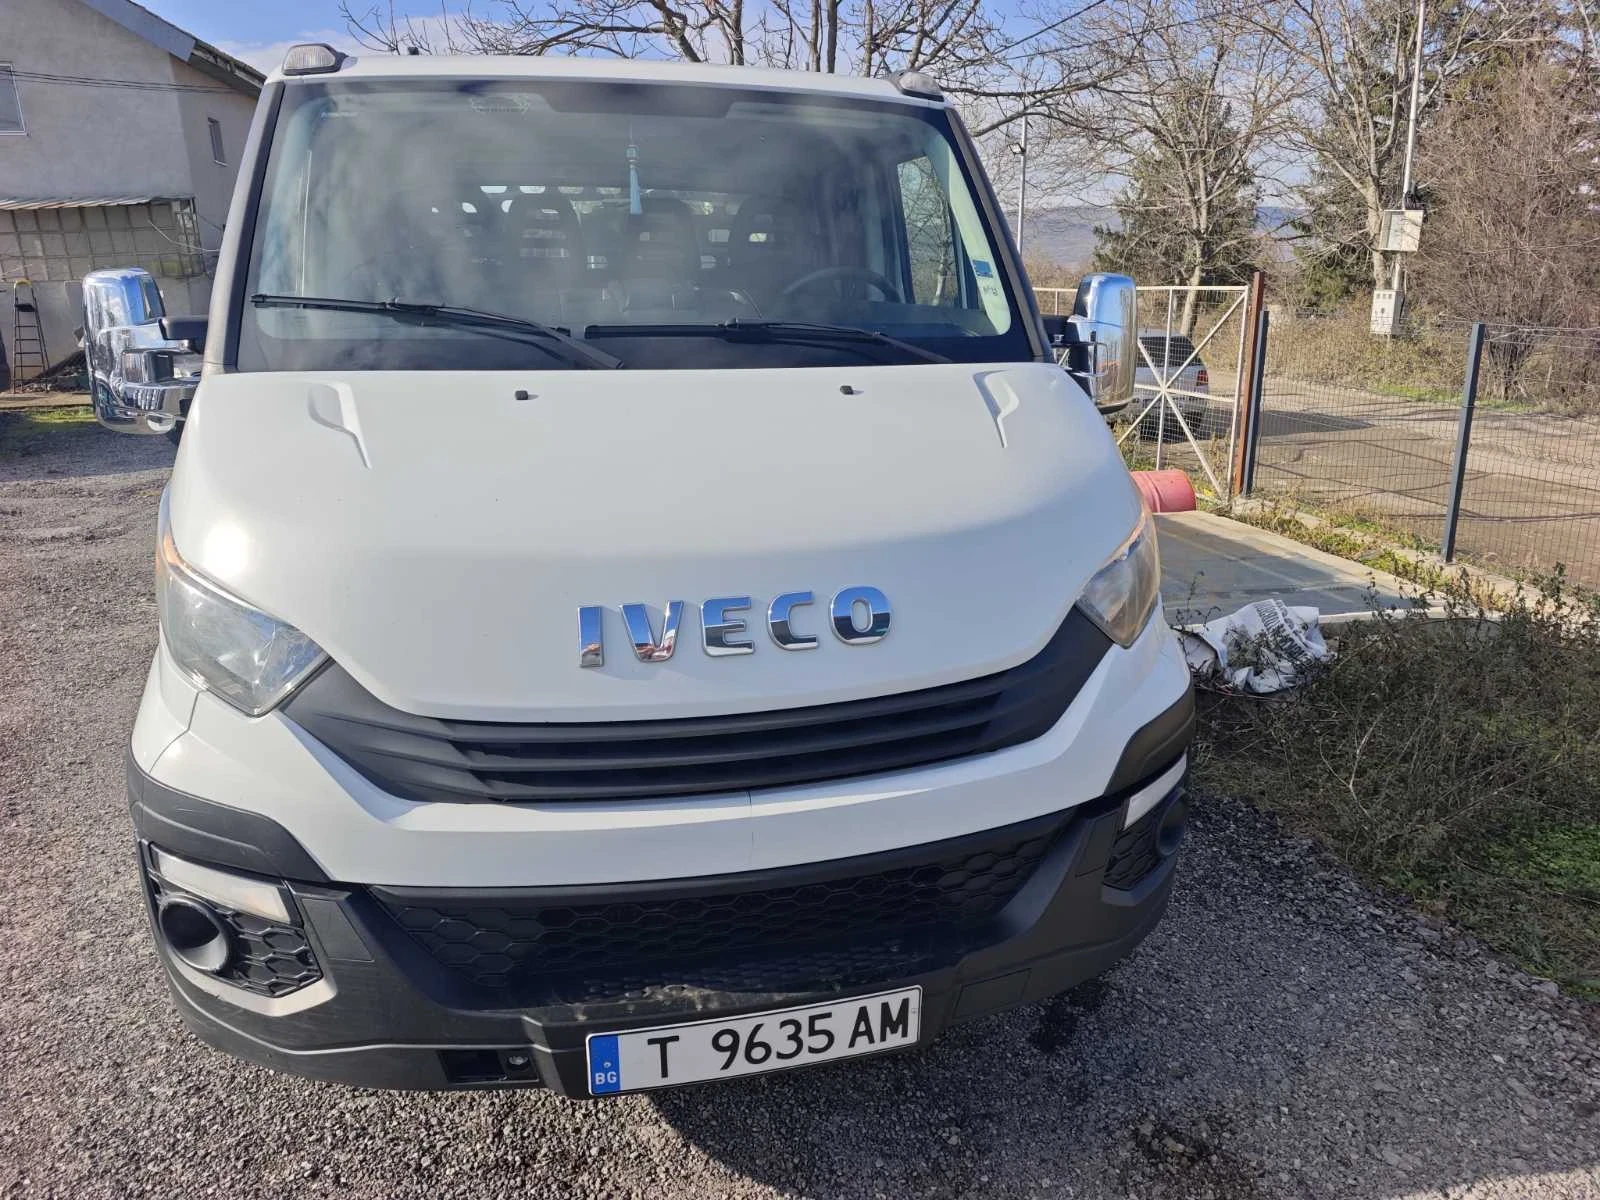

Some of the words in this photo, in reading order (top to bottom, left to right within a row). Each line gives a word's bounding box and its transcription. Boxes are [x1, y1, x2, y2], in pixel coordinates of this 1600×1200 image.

[577, 585, 892, 668] IVECO
[595, 1071, 617, 1085] BG
[647, 1035, 680, 1078] T
[712, 1012, 835, 1071] 9635
[848, 998, 910, 1049] AM
